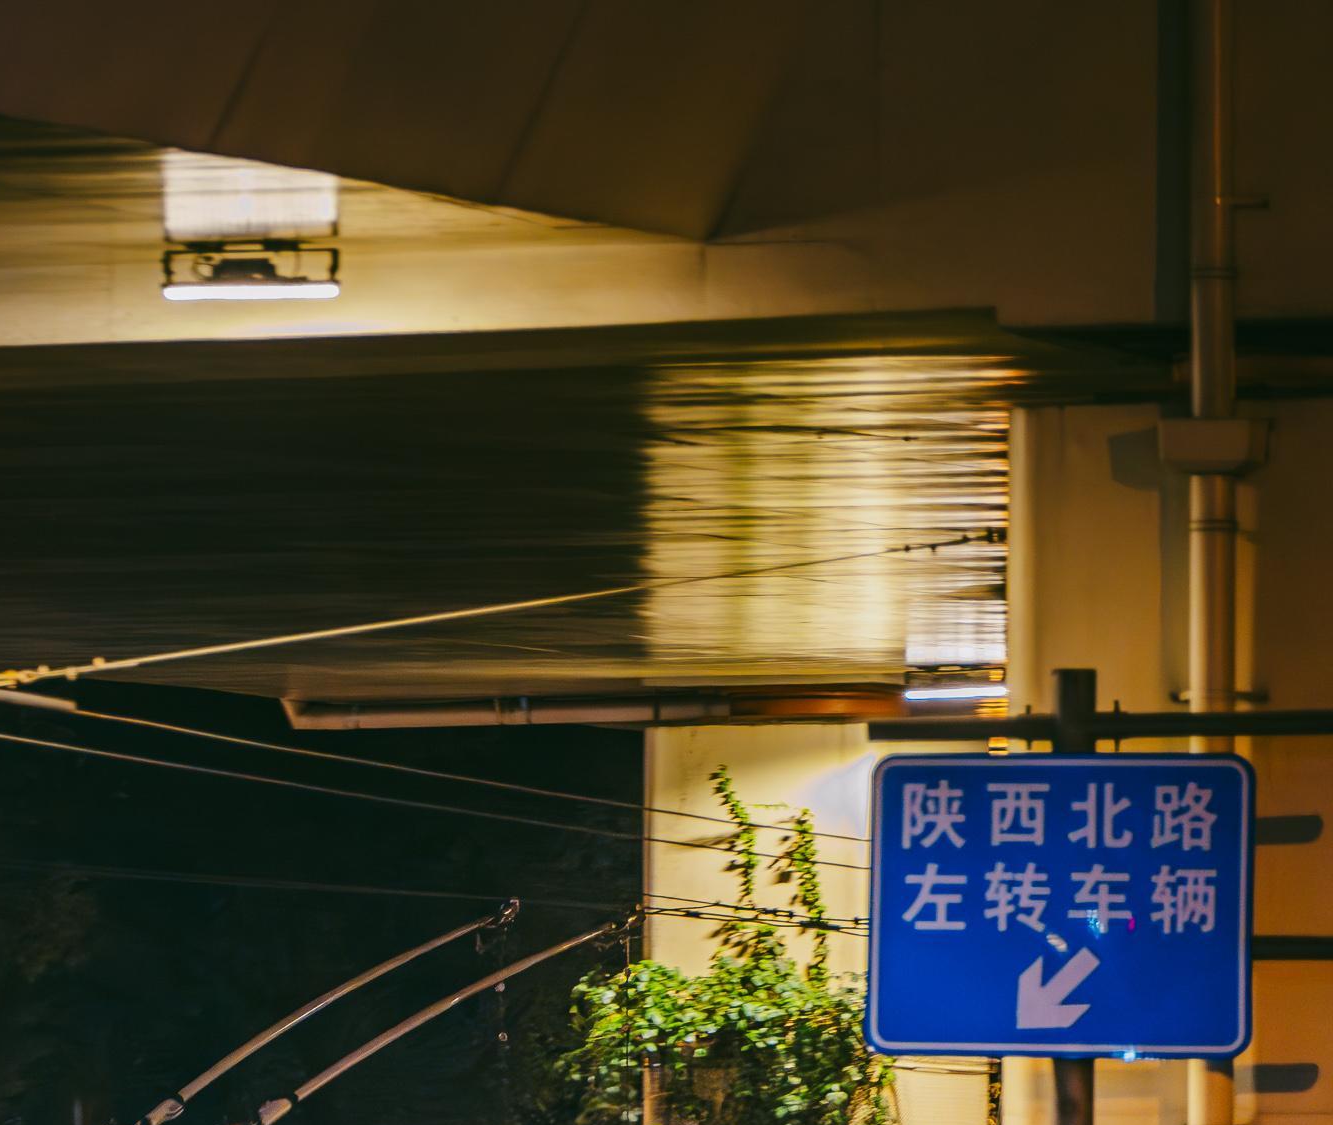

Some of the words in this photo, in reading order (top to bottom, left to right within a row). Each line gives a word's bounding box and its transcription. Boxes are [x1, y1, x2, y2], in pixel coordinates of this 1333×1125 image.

[901, 780, 1218, 851] 陕西北路
[902, 862, 1218, 934] 左转车辆
